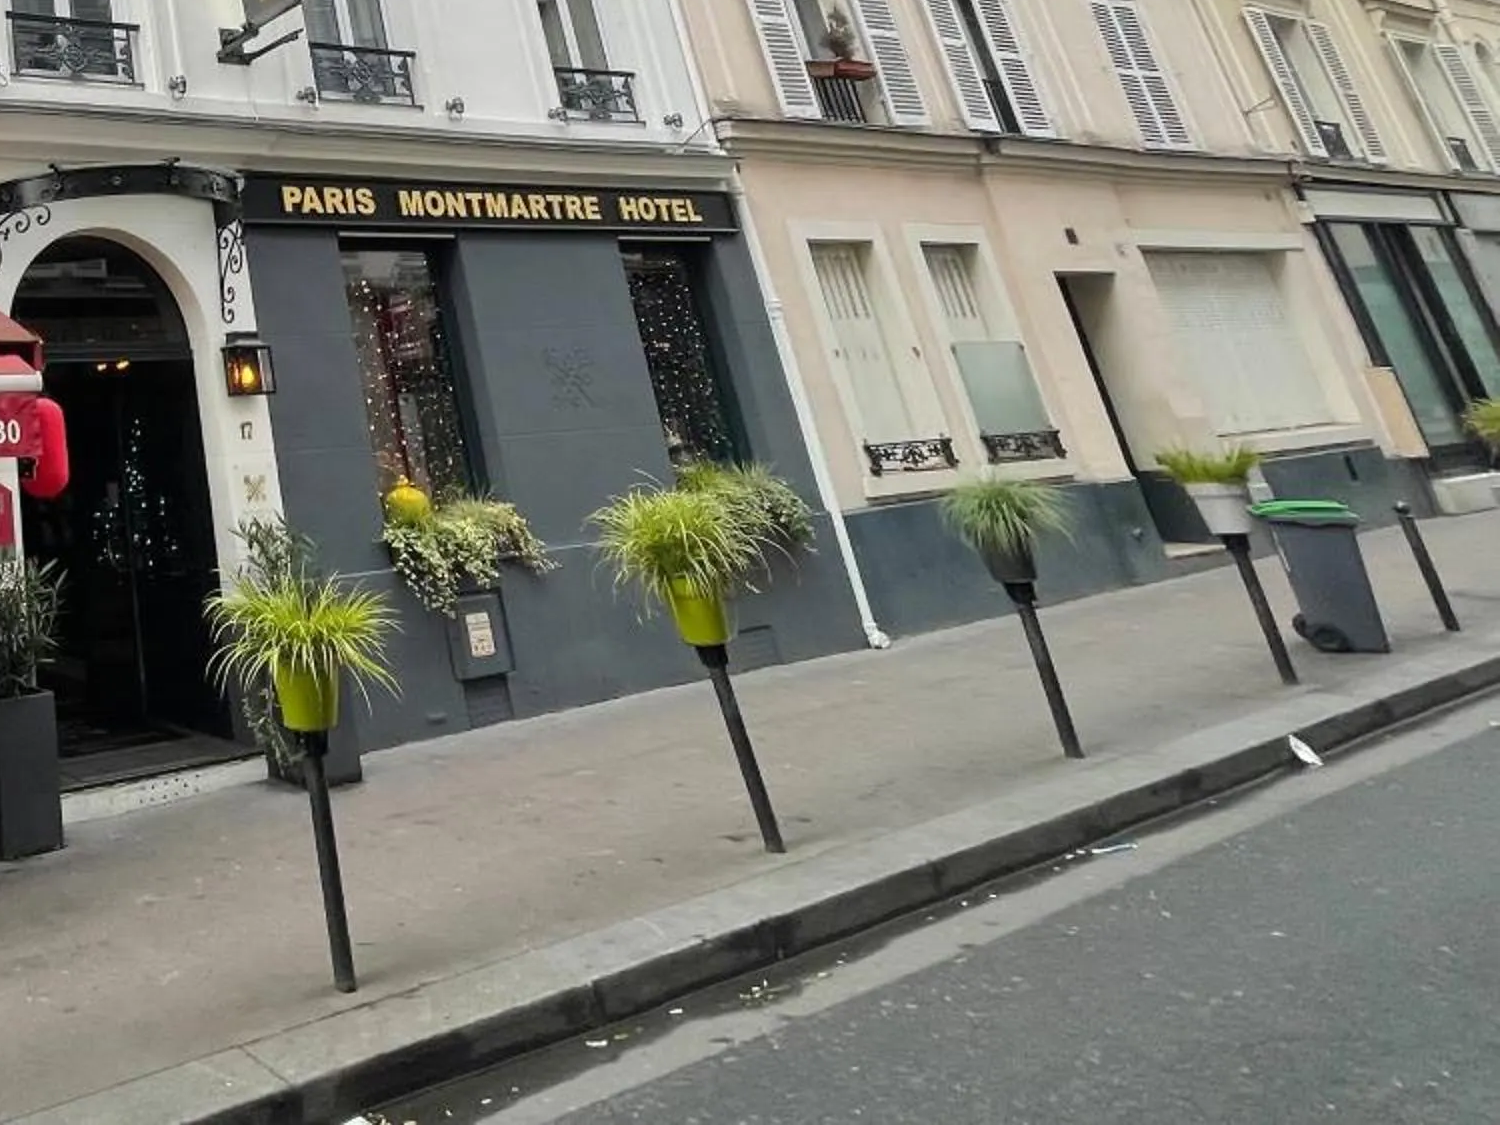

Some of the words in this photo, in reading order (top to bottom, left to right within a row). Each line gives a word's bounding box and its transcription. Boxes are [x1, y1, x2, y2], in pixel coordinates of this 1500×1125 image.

[281, 185, 376, 215] PARIS
[398, 190, 602, 221] MONTMARTRE
[619, 196, 703, 223] HOTEL
